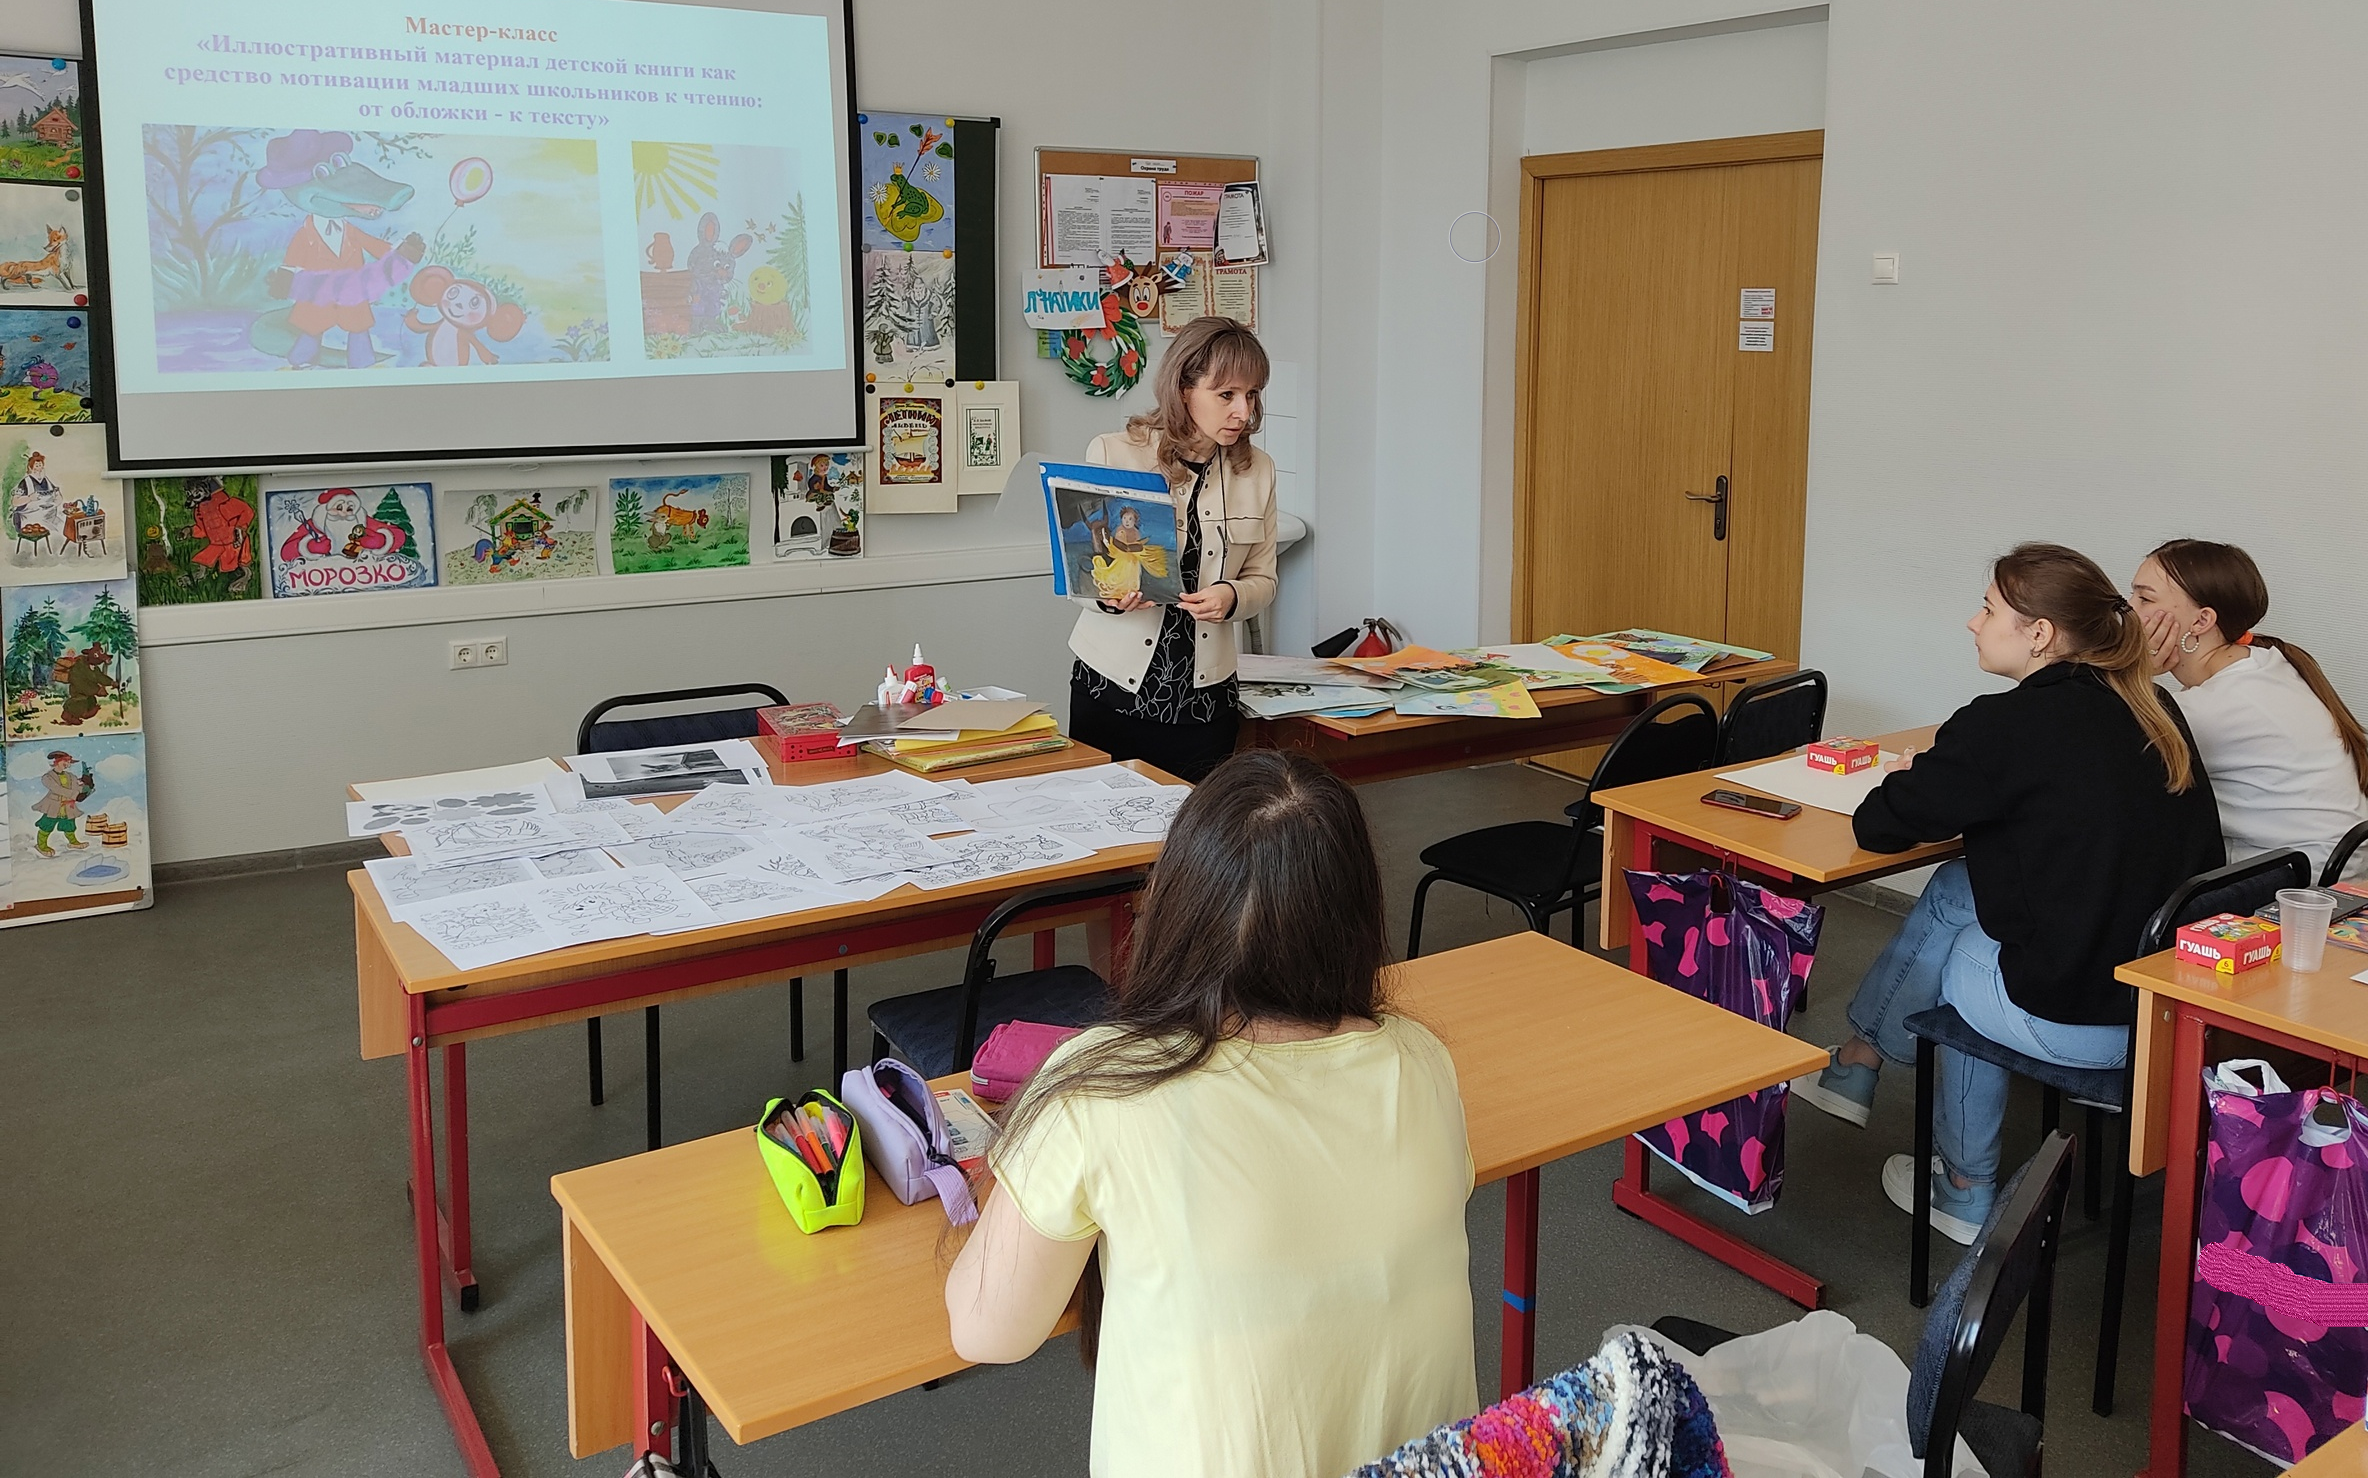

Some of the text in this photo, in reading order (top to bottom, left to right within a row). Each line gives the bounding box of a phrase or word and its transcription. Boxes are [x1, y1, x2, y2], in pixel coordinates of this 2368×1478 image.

[405, 16, 558, 43] Мастер-класс
[196, 34, 737, 81] «Иллюстративный материал детской книги как
[164, 66, 763, 108] средство мотивации младших школьников к чтению:
[358, 103, 383, 117] от
[390, 101, 488, 121] обложки
[509, 109, 522, 123] к
[528, 109, 610, 130] тексту»
[1024, 288, 1100, 313] ЛУНАТИКИ
[288, 563, 407, 588] МОРОЗКО
[1809, 752, 1838, 766] ГУАШЬ
[1851, 754, 1872, 769] ГУАШЬ
[2179, 938, 2222, 960] ГУАШЬ
[2243, 945, 2272, 966] ГУАШЬ
[2224, 960, 2229, 968] 6
